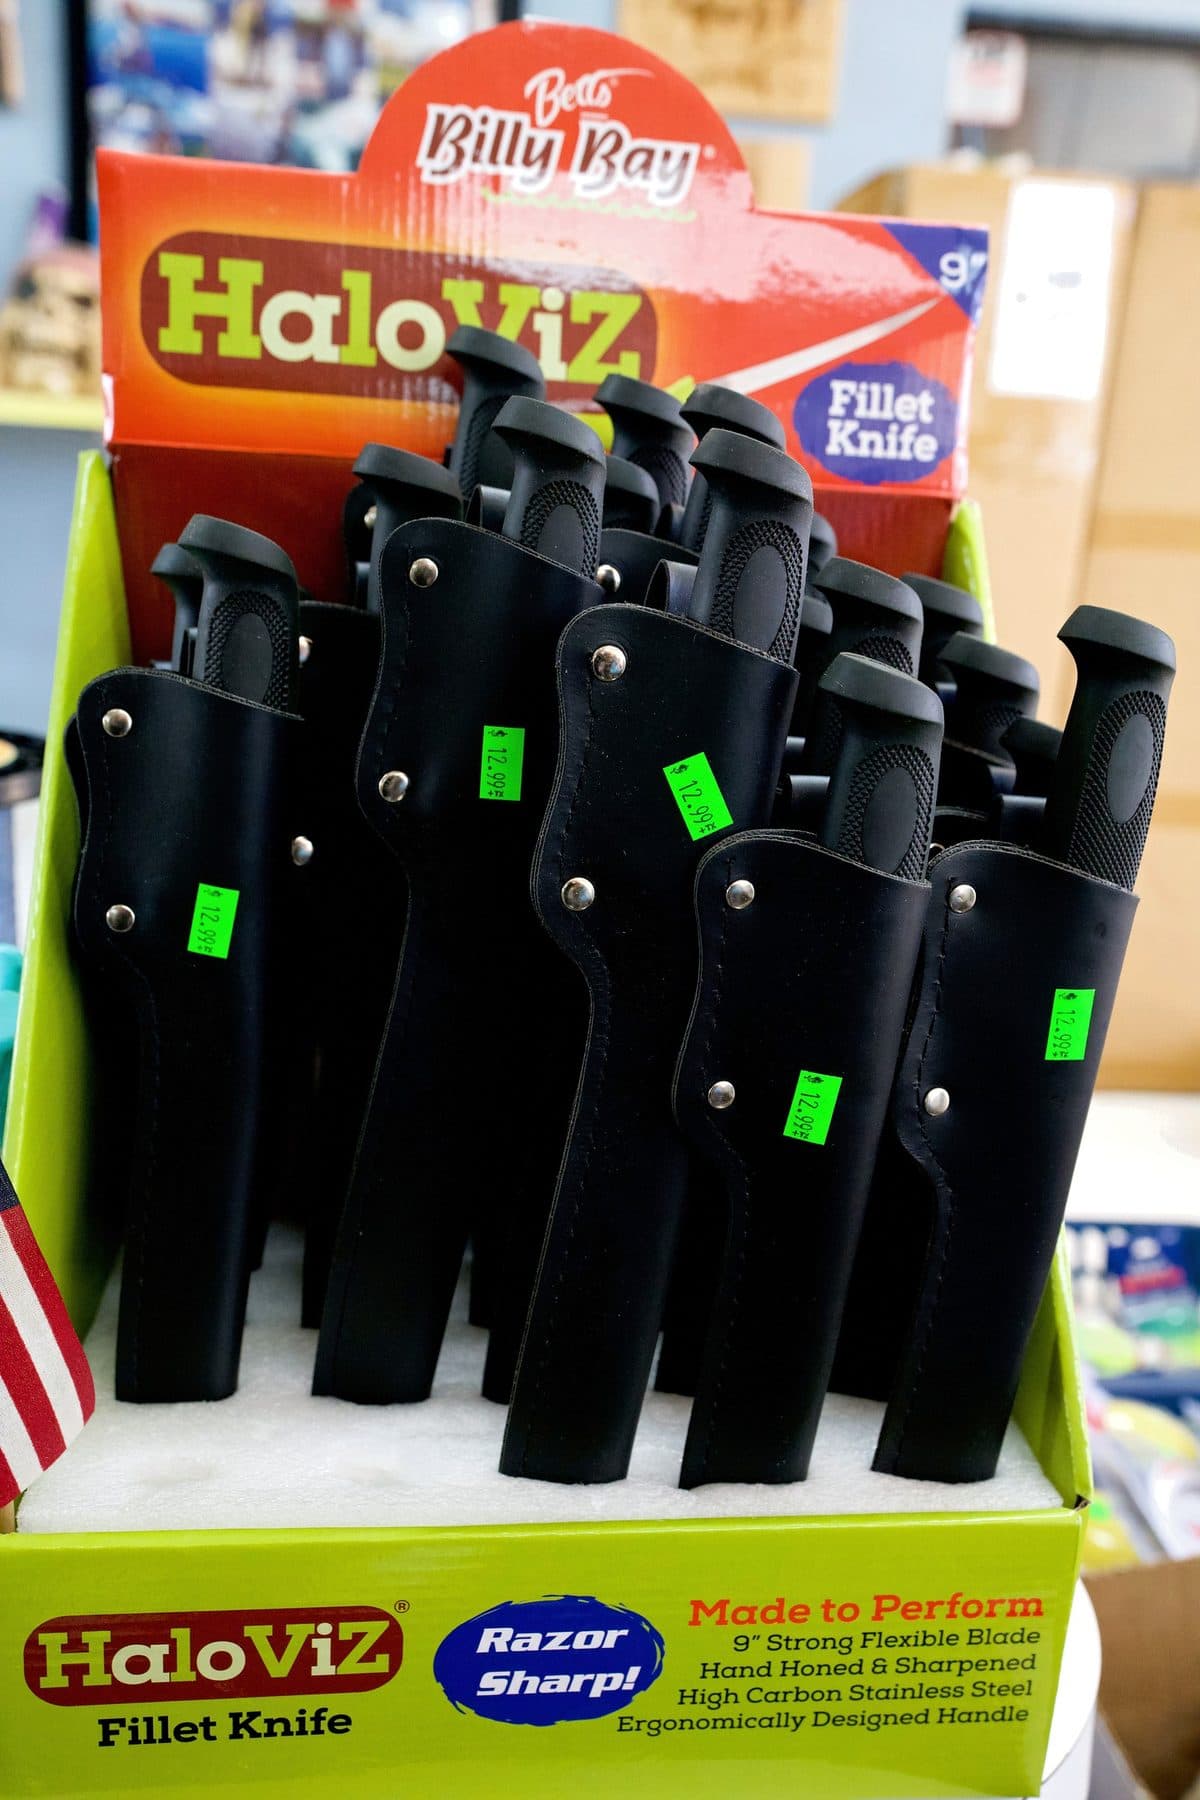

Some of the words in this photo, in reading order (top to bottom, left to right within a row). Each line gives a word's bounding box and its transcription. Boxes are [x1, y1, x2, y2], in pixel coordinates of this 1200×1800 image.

[416, 103, 565, 194] Billy
[568, 118, 700, 207] Bay
[828, 379, 936, 424] Fillet
[825, 419, 939, 463] Knife
[688, 1598, 811, 1626] Made
[820, 1598, 861, 1623] to
[871, 1592, 1044, 1621] Perform
[38, 1620, 391, 1689] HaloViZ
[475, 1627, 629, 1654] Razor
[733, 1634, 760, 1652] 9"
[766, 1633, 853, 1656] Strong
[859, 1629, 960, 1649] Flexible
[965, 1627, 1041, 1647] Blade
[475, 1666, 642, 1699] Sharp!
[699, 1660, 772, 1679] Hand
[779, 1658, 864, 1678] Honed
[871, 1657, 887, 1675] &
[895, 1653, 1037, 1677] Sharpened
[677, 1687, 740, 1710] High
[746, 1685, 842, 1704] Carbon
[849, 1682, 965, 1701] Stainless
[971, 1680, 1033, 1698] Steel
[98, 1713, 218, 1747] Fillet
[228, 1707, 353, 1740] Knife
[616, 1711, 806, 1737] Ergonomically
[811, 1709, 930, 1732] Designed
[936, 1705, 1030, 1725] Handle
